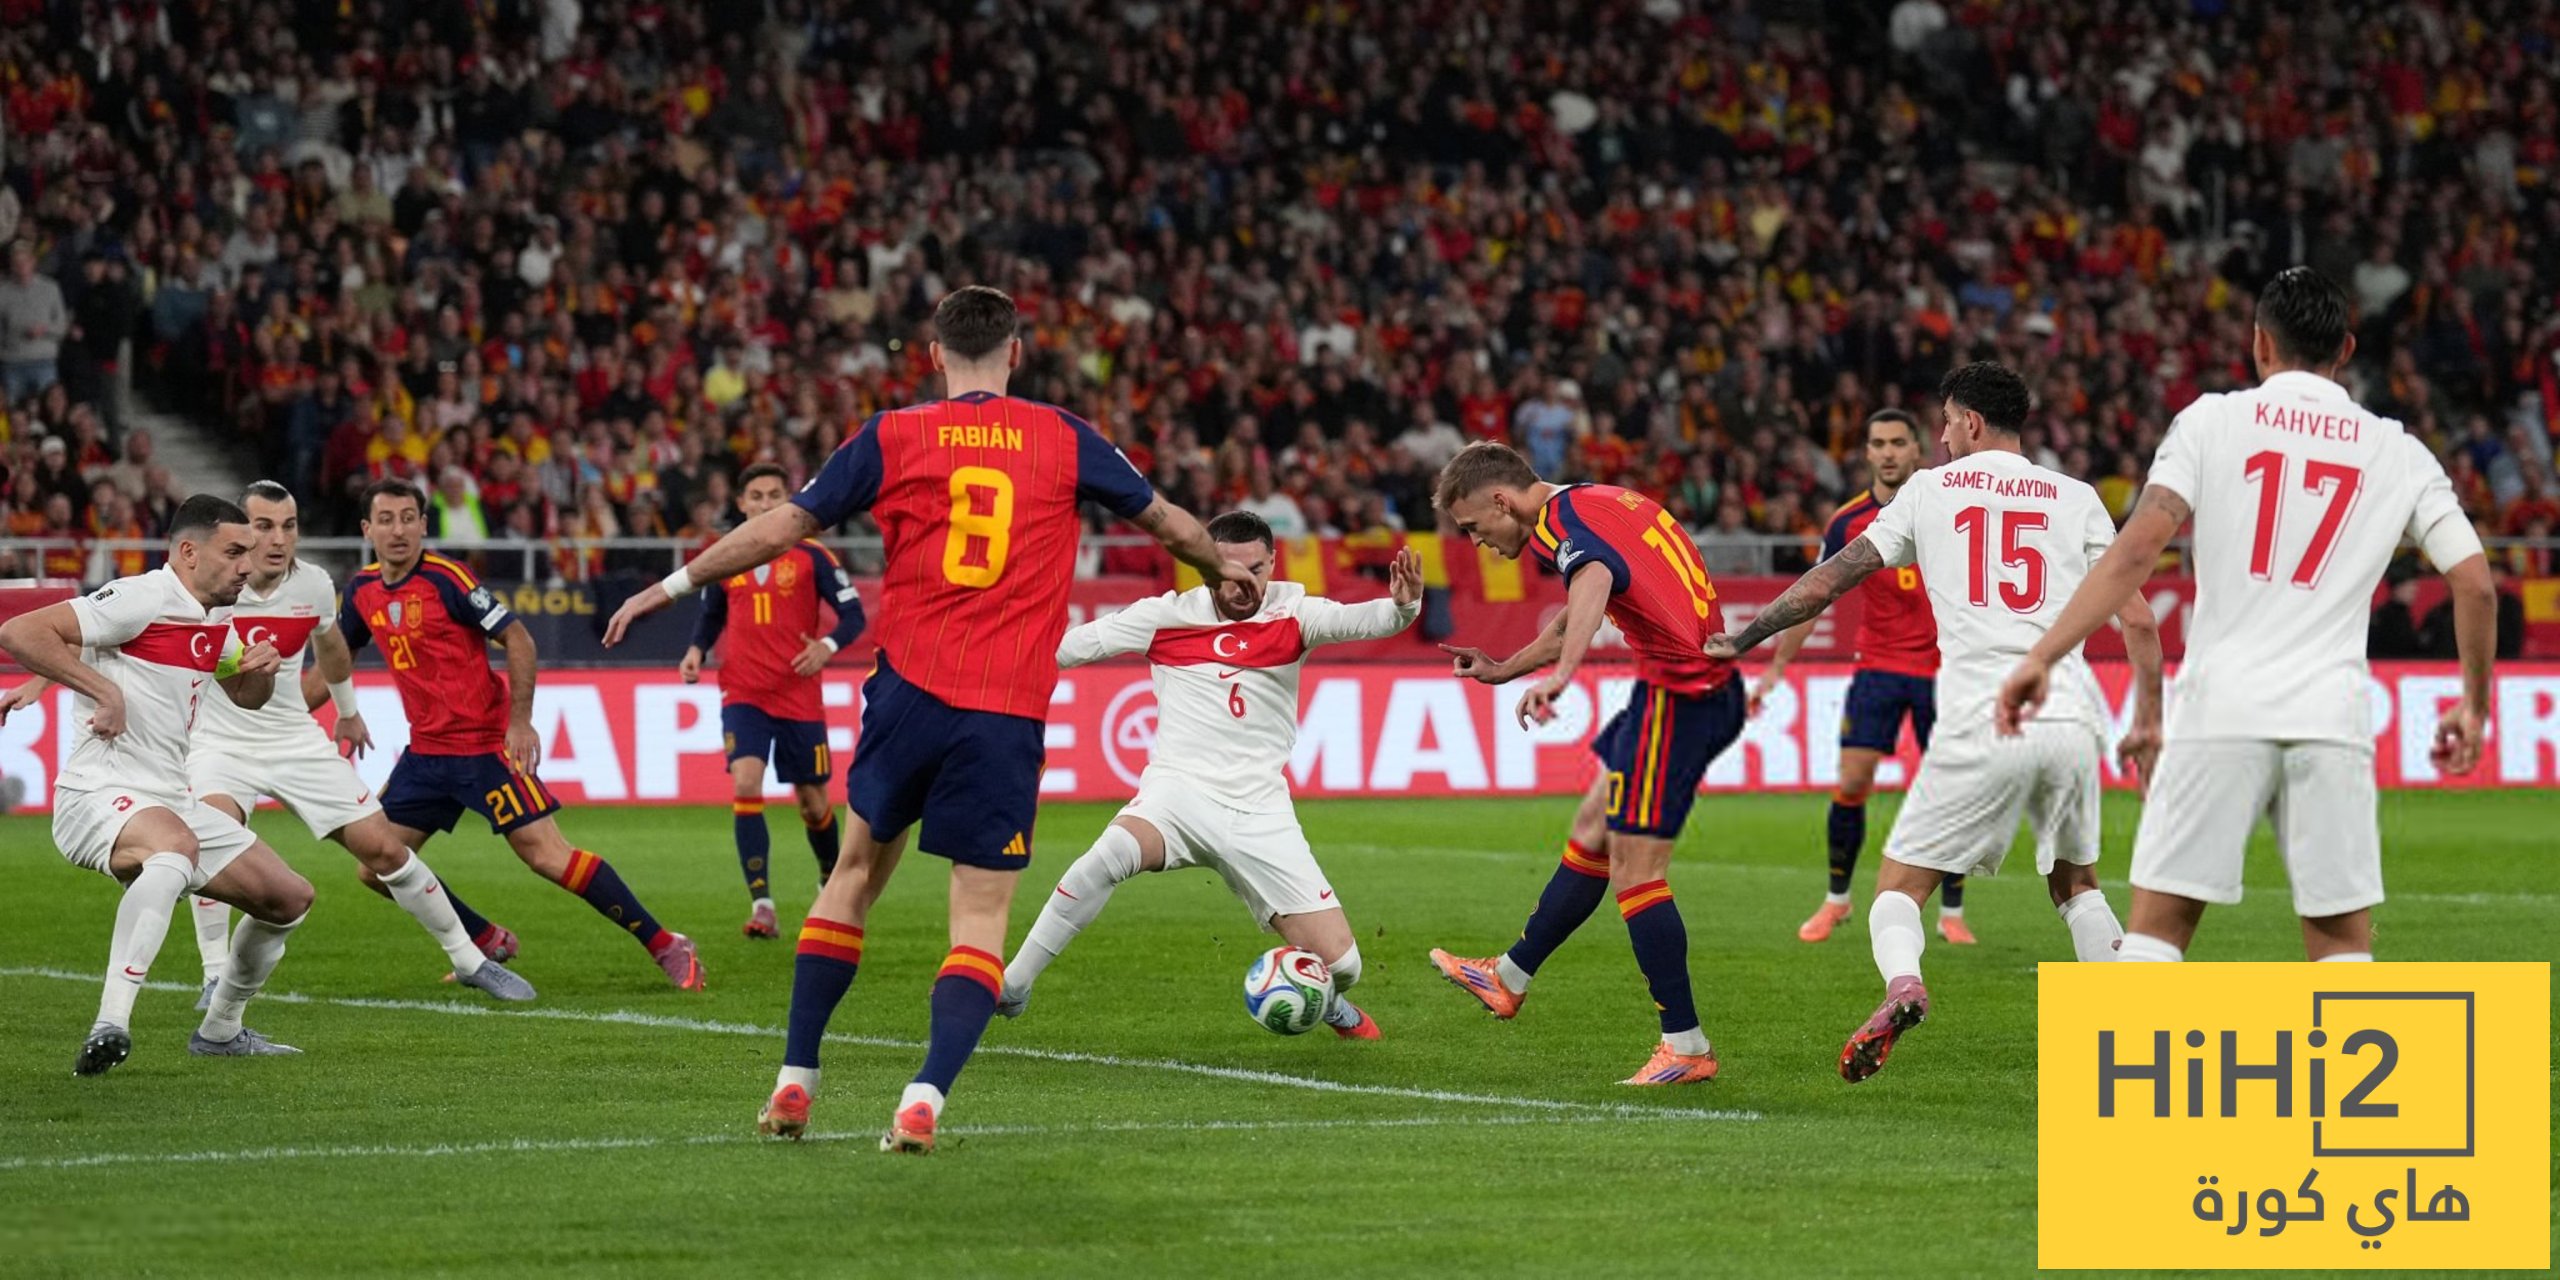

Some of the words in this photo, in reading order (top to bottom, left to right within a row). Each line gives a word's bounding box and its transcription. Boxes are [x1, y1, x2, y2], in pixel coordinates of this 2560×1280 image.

[938, 422, 1022, 451] FABIÁN
[1942, 471, 1995, 490] SAMET
[1995, 478, 2057, 500] AKAYDIN
[942, 466, 1014, 588] 8
[2245, 450, 2364, 590] 17
[1955, 505, 2049, 614] 15
[753, 592, 771, 624] 11
[388, 635, 418, 670] 21
[1228, 682, 1246, 719] 6
[815, 743, 829, 776] 11
[112, 795, 134, 811] 3
[485, 783, 524, 826] 21
